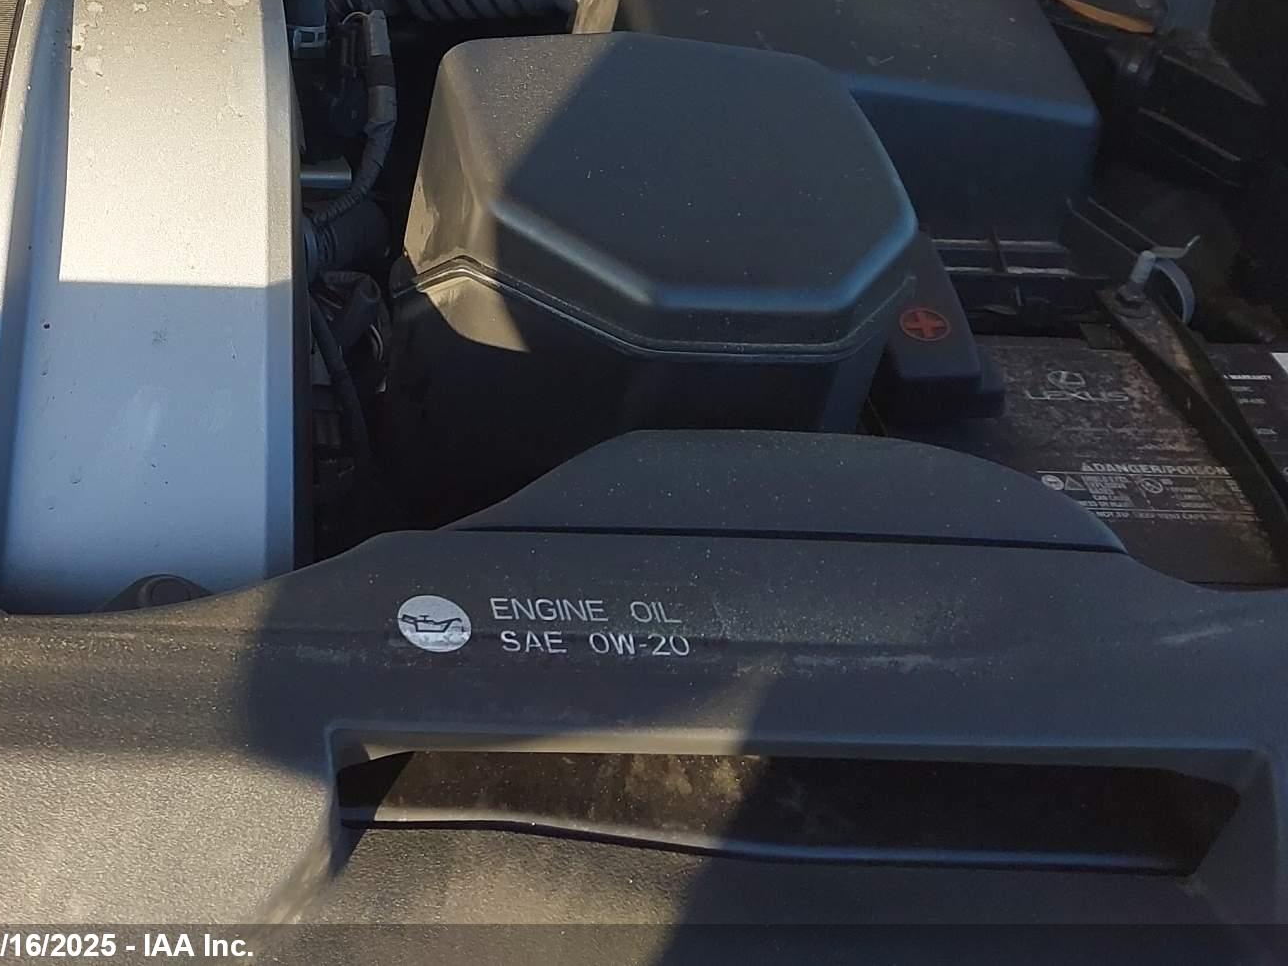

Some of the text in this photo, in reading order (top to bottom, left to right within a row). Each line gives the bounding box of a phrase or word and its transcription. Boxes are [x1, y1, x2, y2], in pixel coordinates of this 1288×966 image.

[1024, 389, 1129, 402] LEXUS
[490, 598, 682, 623] ENGINE OIL
[501, 631, 690, 656] SAE 0W-20
